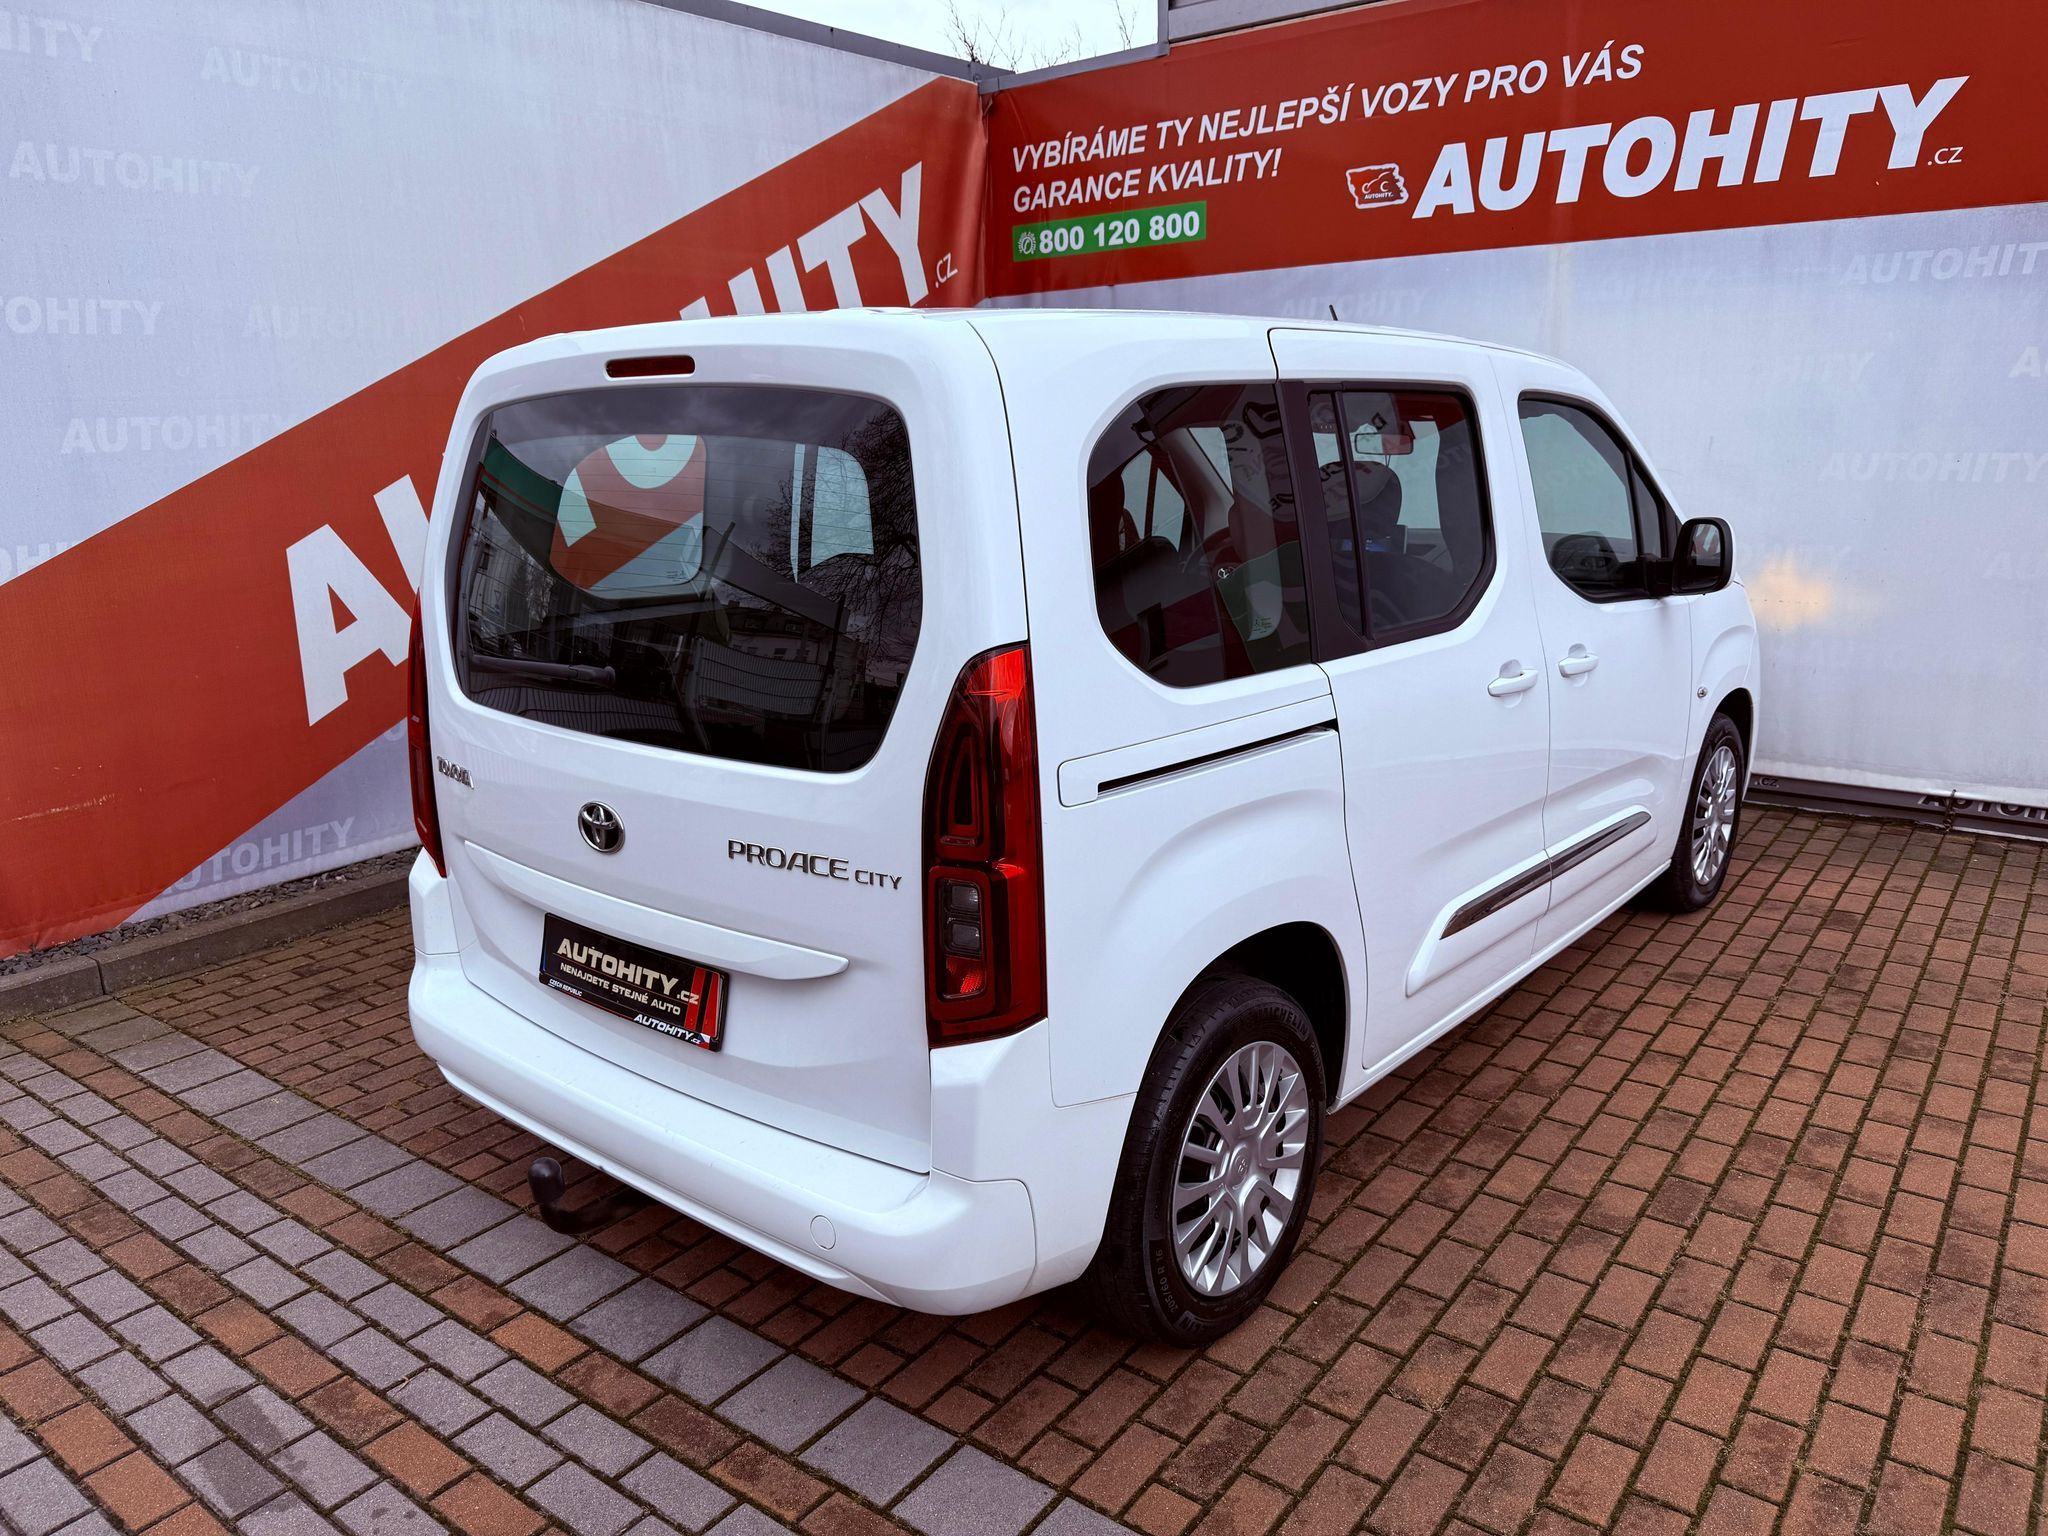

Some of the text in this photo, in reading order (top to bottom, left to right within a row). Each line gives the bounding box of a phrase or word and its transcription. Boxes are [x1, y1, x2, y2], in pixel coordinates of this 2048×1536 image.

[1012, 40, 1645, 173] VYBÍRÁME TY NEJLEPŠÍ VOZY PRO VÁS
[9, 141, 261, 198] AUTOHITY
[1013, 147, 1282, 213] GARANCE KVALITY!
[1038, 225, 1084, 254] 800
[1093, 218, 1140, 247] 120
[1148, 210, 1200, 241] 800
[727, 838, 902, 890] PROACE CITY
[559, 962, 681, 1016] NENAJDETE STEJNÉ AUTO
